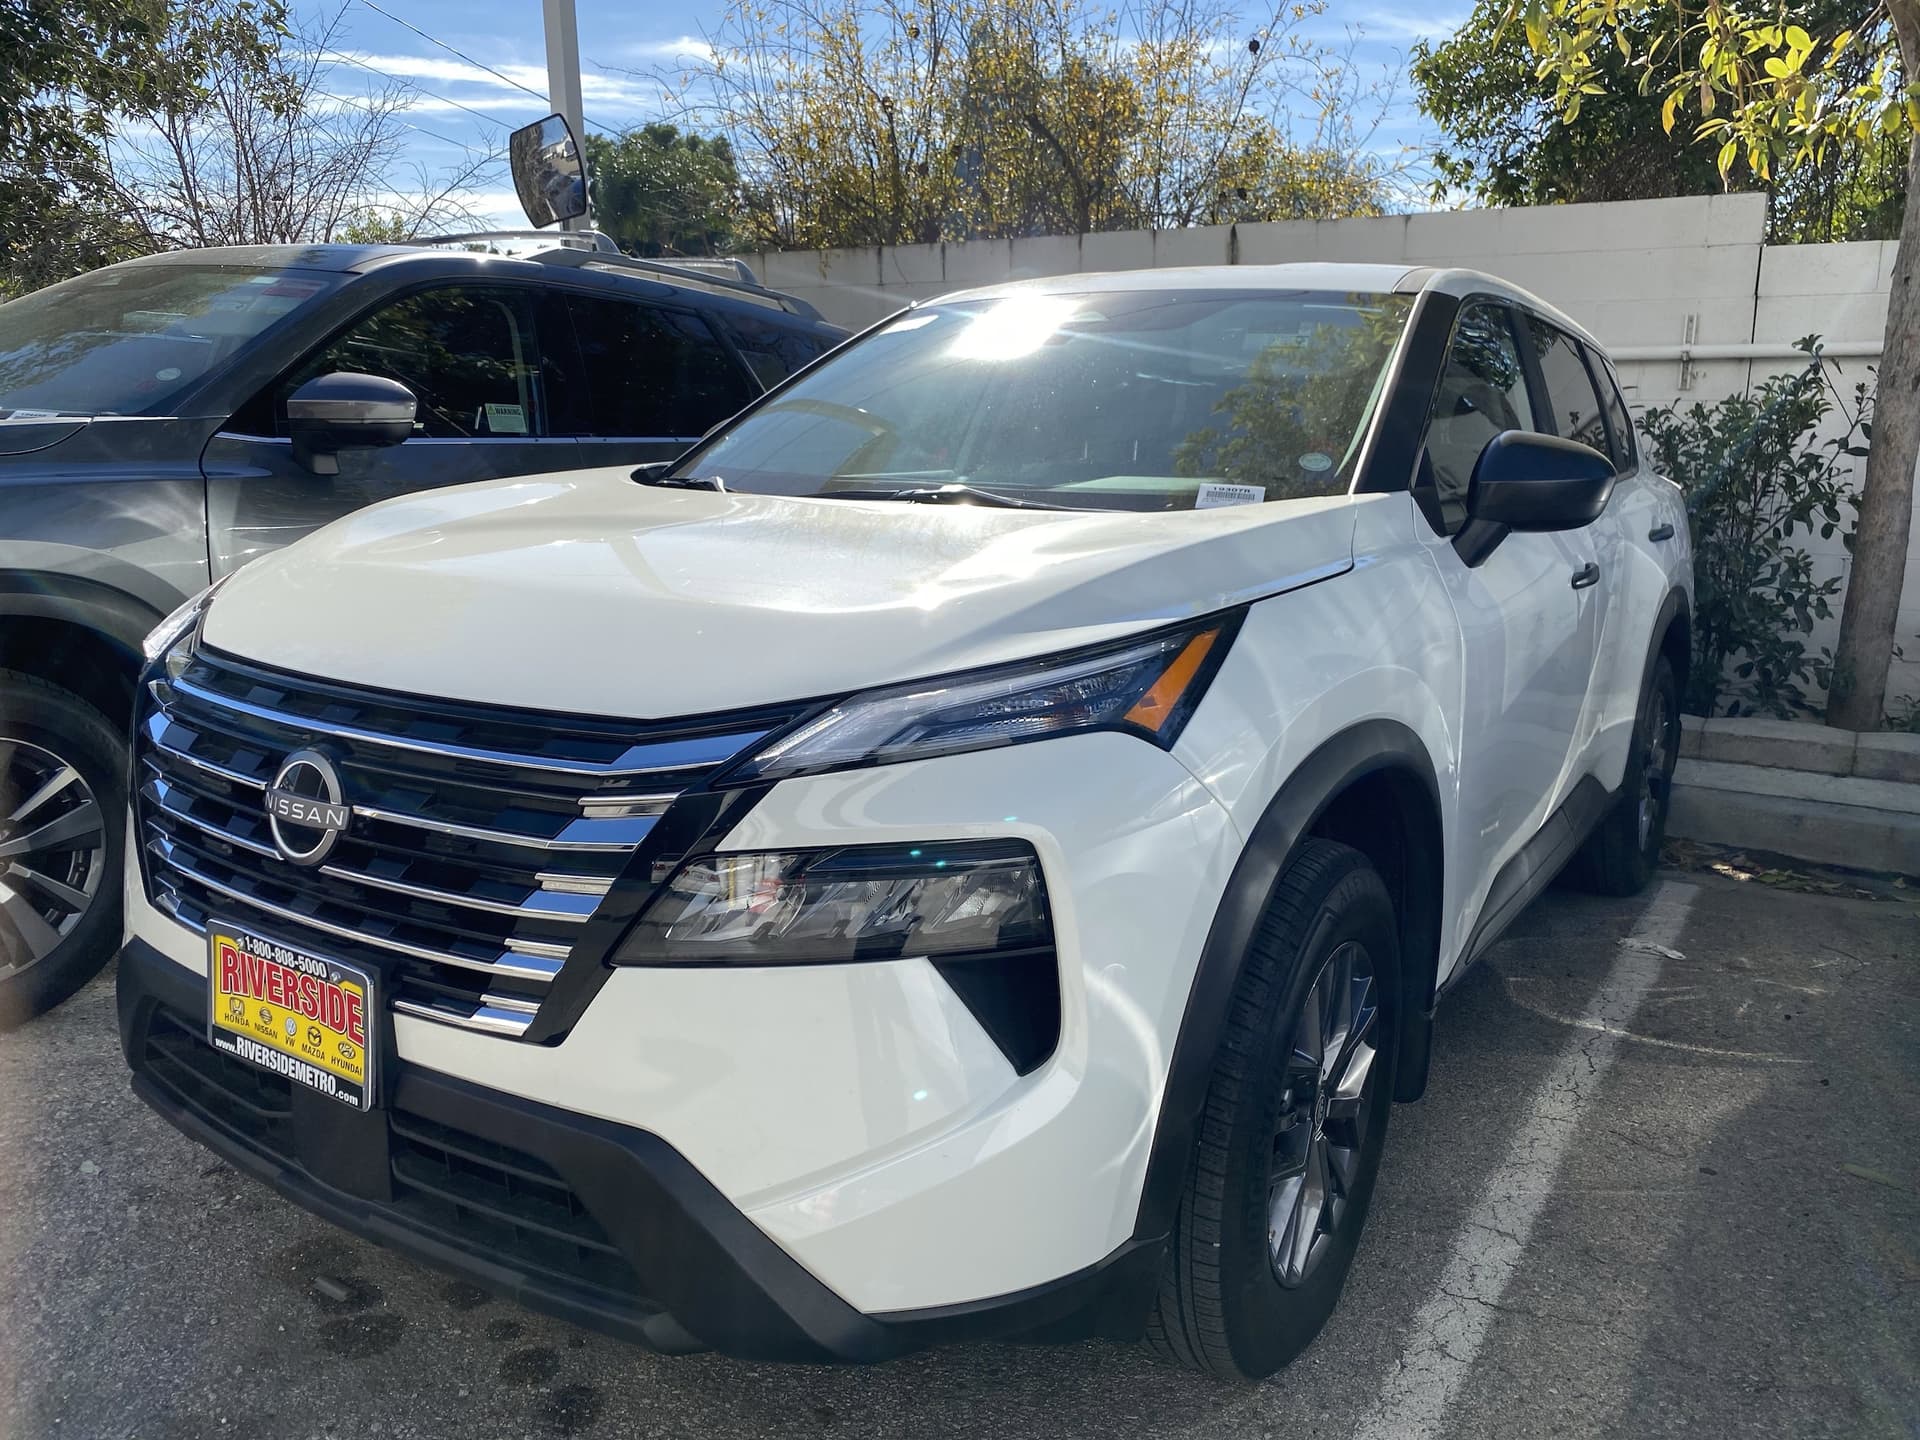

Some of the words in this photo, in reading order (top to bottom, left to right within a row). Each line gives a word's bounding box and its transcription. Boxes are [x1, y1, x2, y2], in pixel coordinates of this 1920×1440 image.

[495, 407, 522, 416] WARNING
[264, 791, 344, 826] NISSAN
[245, 936, 328, 978] 1-800-808-5000
[220, 943, 364, 1048] RIVERSIDE
[215, 1036, 359, 1106] www.RIVERSIDEMETRO.com
[224, 1012, 250, 1028] HONDA
[254, 1023, 278, 1040] NISSAN
[285, 1036, 295, 1047] VW
[301, 1043, 325, 1060] MAZDA
[330, 1055, 362, 1077] HYUNDAI
